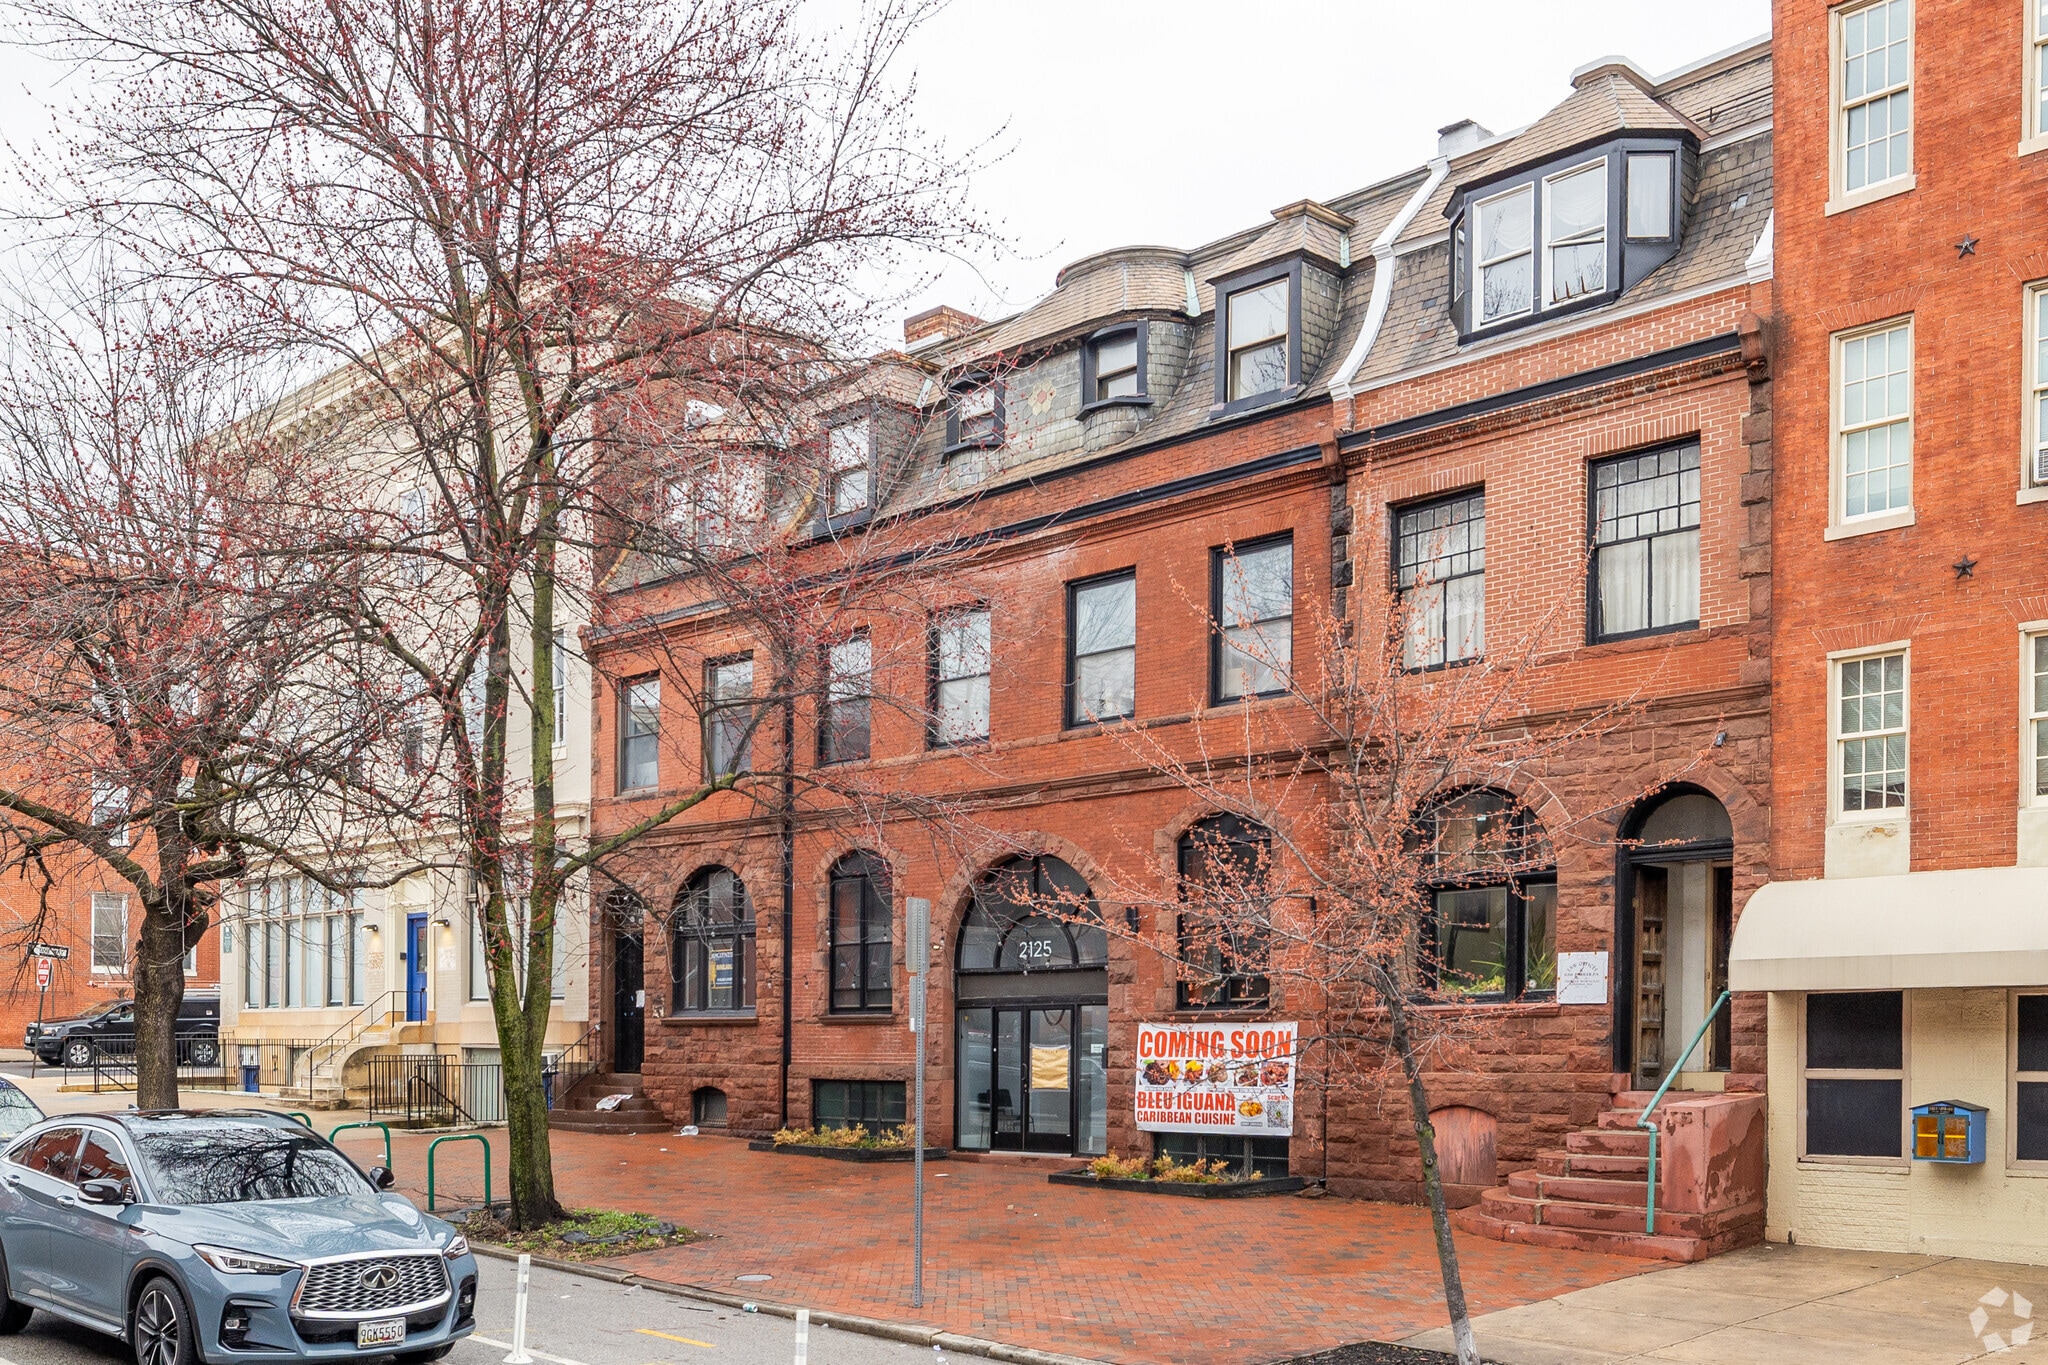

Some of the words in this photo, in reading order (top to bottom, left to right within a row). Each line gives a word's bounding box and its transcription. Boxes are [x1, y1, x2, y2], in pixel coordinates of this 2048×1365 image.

[1018, 940, 1052, 958] 2125
[1139, 1031, 1225, 1058] COMING
[1231, 1031, 1292, 1058] SOON
[1137, 1091, 1174, 1110] BLEU
[1177, 1092, 1236, 1112] IGUANA
[1137, 1110, 1192, 1124] CARIBBEAN
[1194, 1112, 1236, 1126] CUISINE
[361, 1325, 403, 1343] 9GK5550
